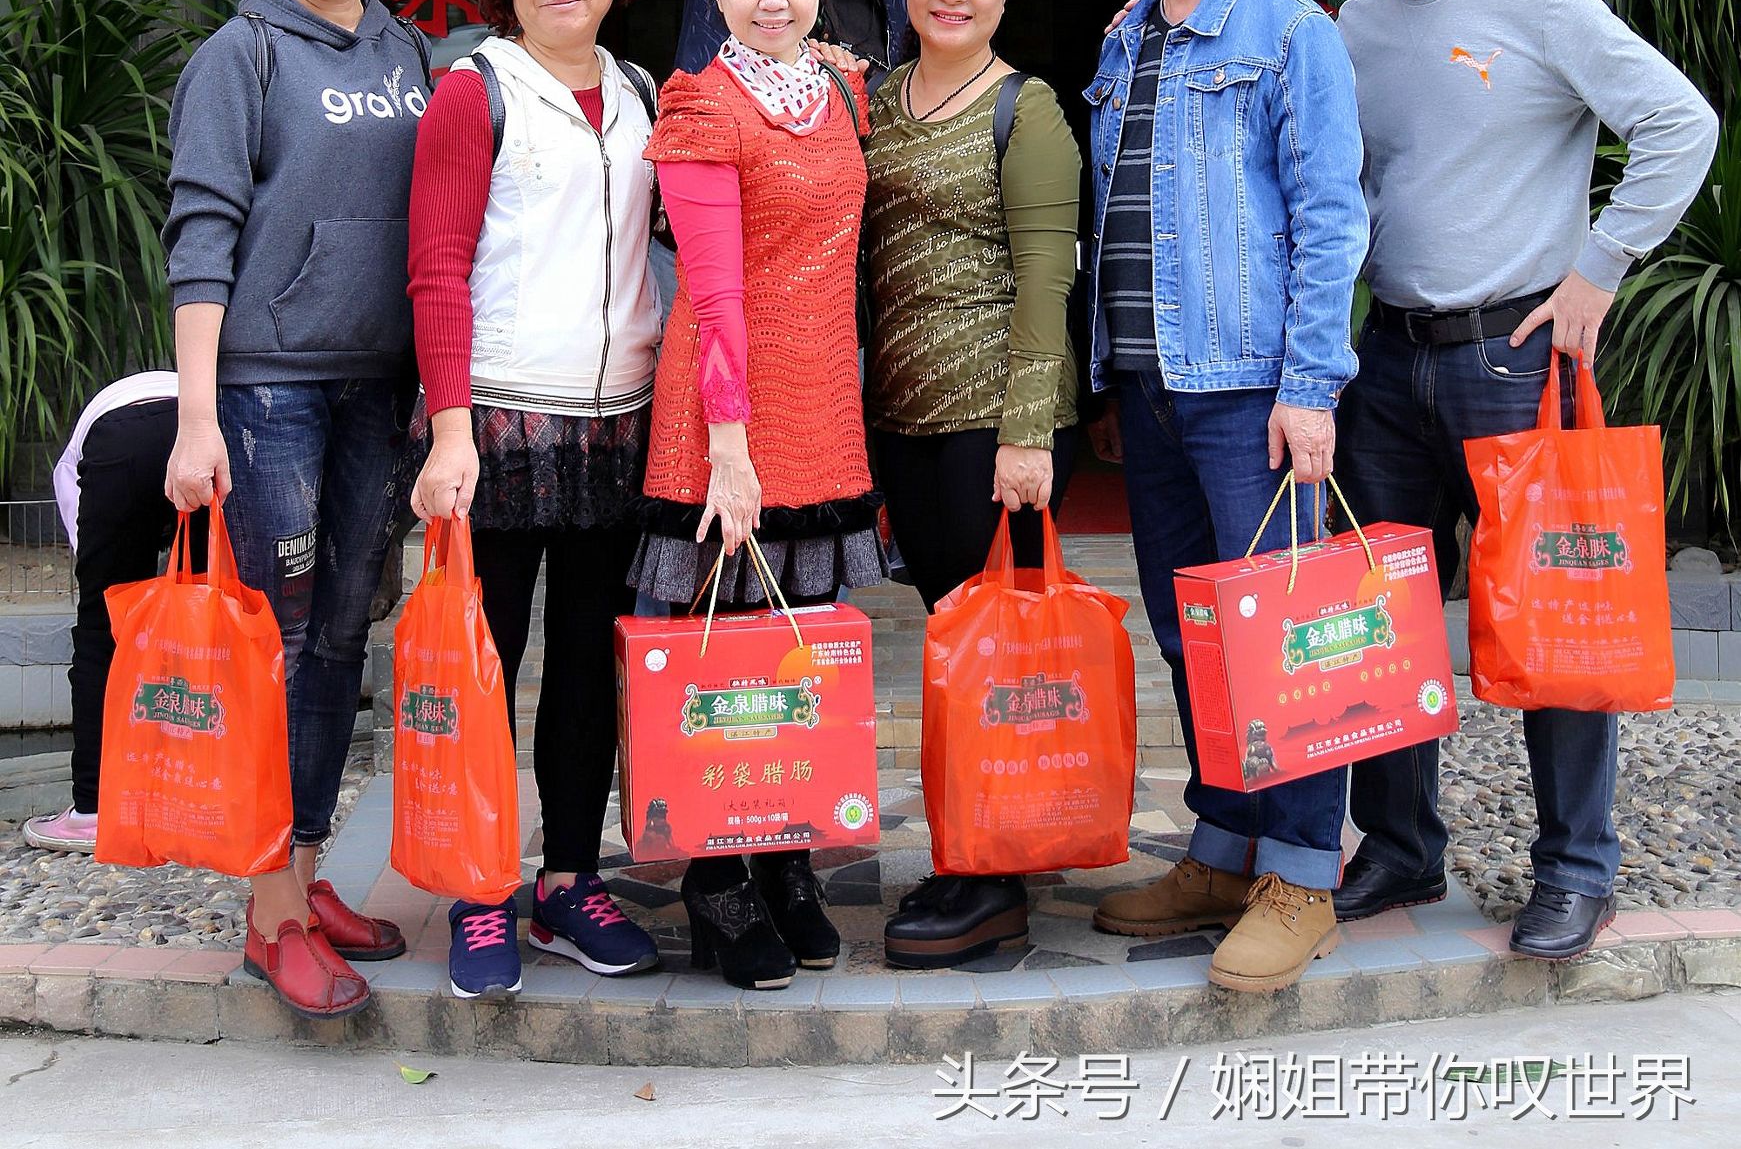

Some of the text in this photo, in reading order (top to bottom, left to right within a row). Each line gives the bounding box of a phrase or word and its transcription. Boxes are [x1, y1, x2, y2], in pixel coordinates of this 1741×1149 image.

[1305, 614, 1369, 649] 金泉腊味
[710, 691, 789, 716] 金泉腊味
[702, 759, 814, 791] 彩袋腊肠
